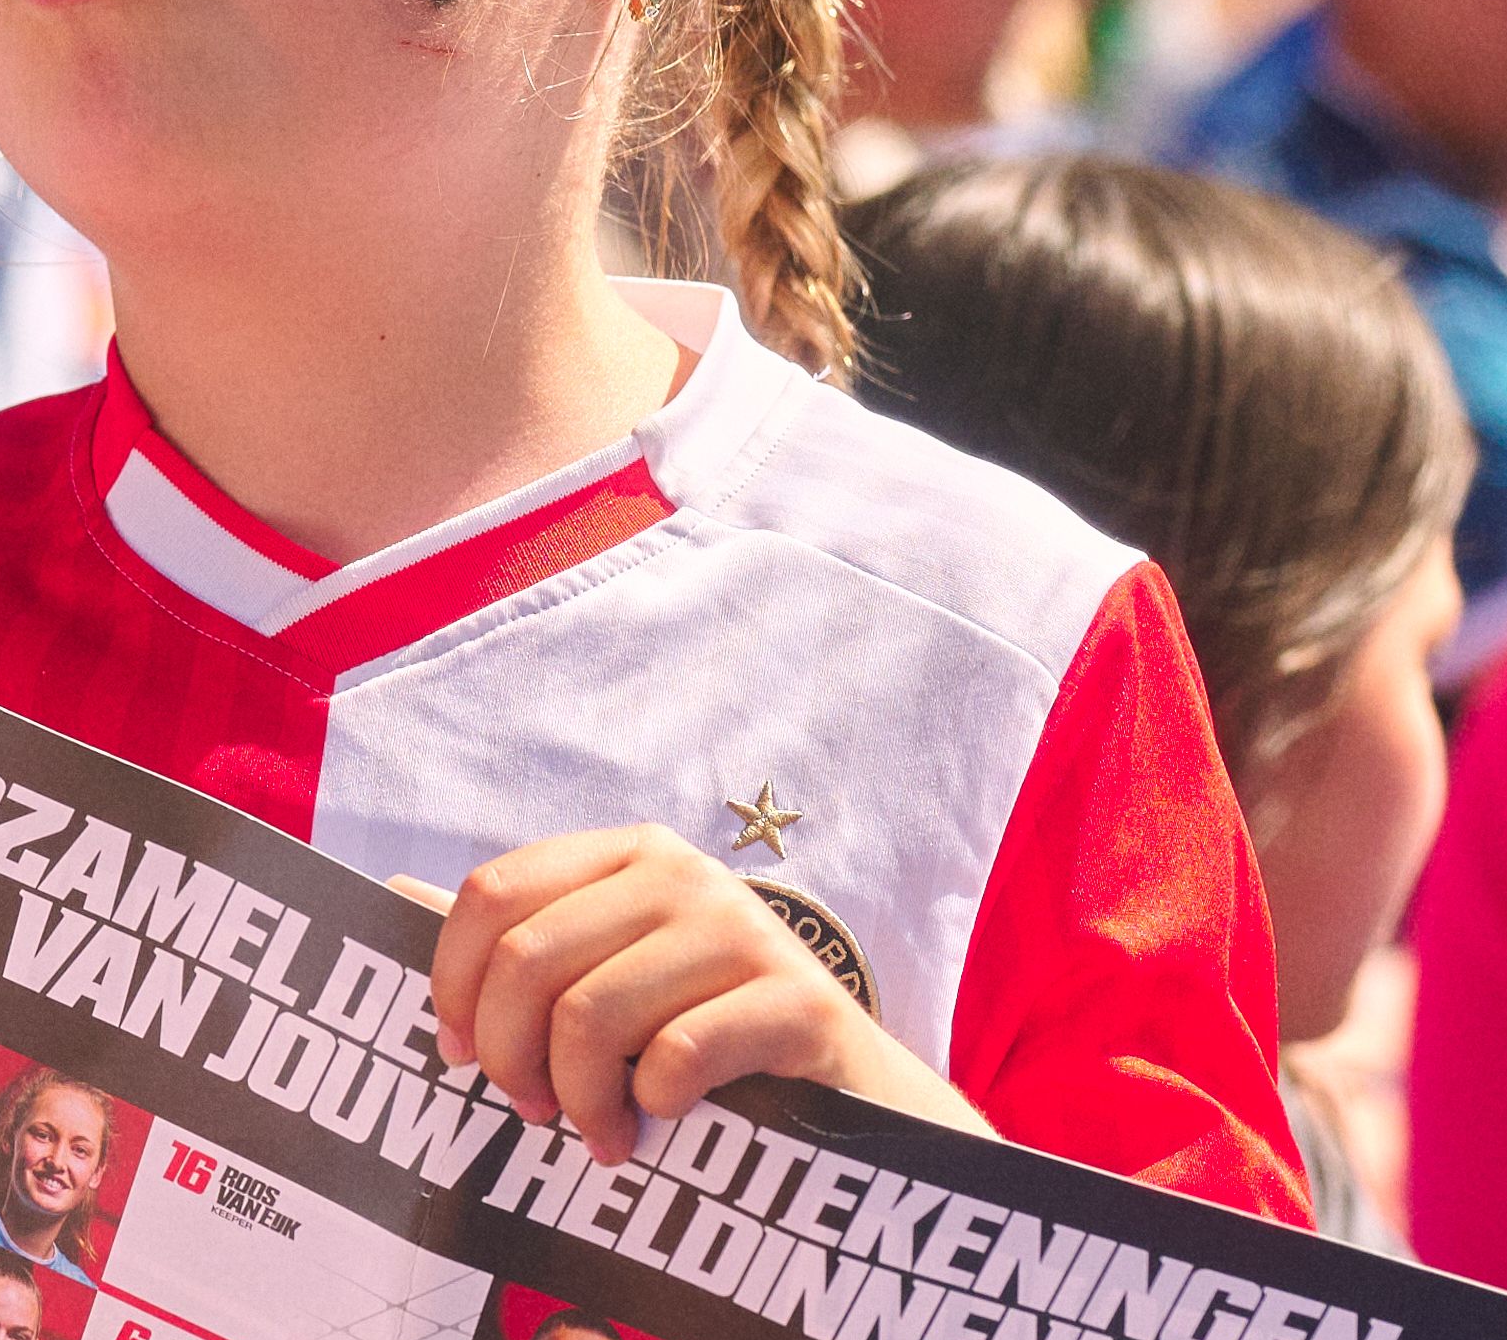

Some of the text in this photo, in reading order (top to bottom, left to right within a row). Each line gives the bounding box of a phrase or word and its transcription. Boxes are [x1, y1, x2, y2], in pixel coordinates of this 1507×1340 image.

[306, 935, 440, 1072] DE
[2, 889, 224, 1059] VAN
[202, 992, 510, 1190] JOUW
[163, 1140, 217, 1195] 16
[219, 1165, 280, 1207] ROOS
[211, 1205, 252, 1231] KEEPER
[216, 1185, 261, 1221] VAN
